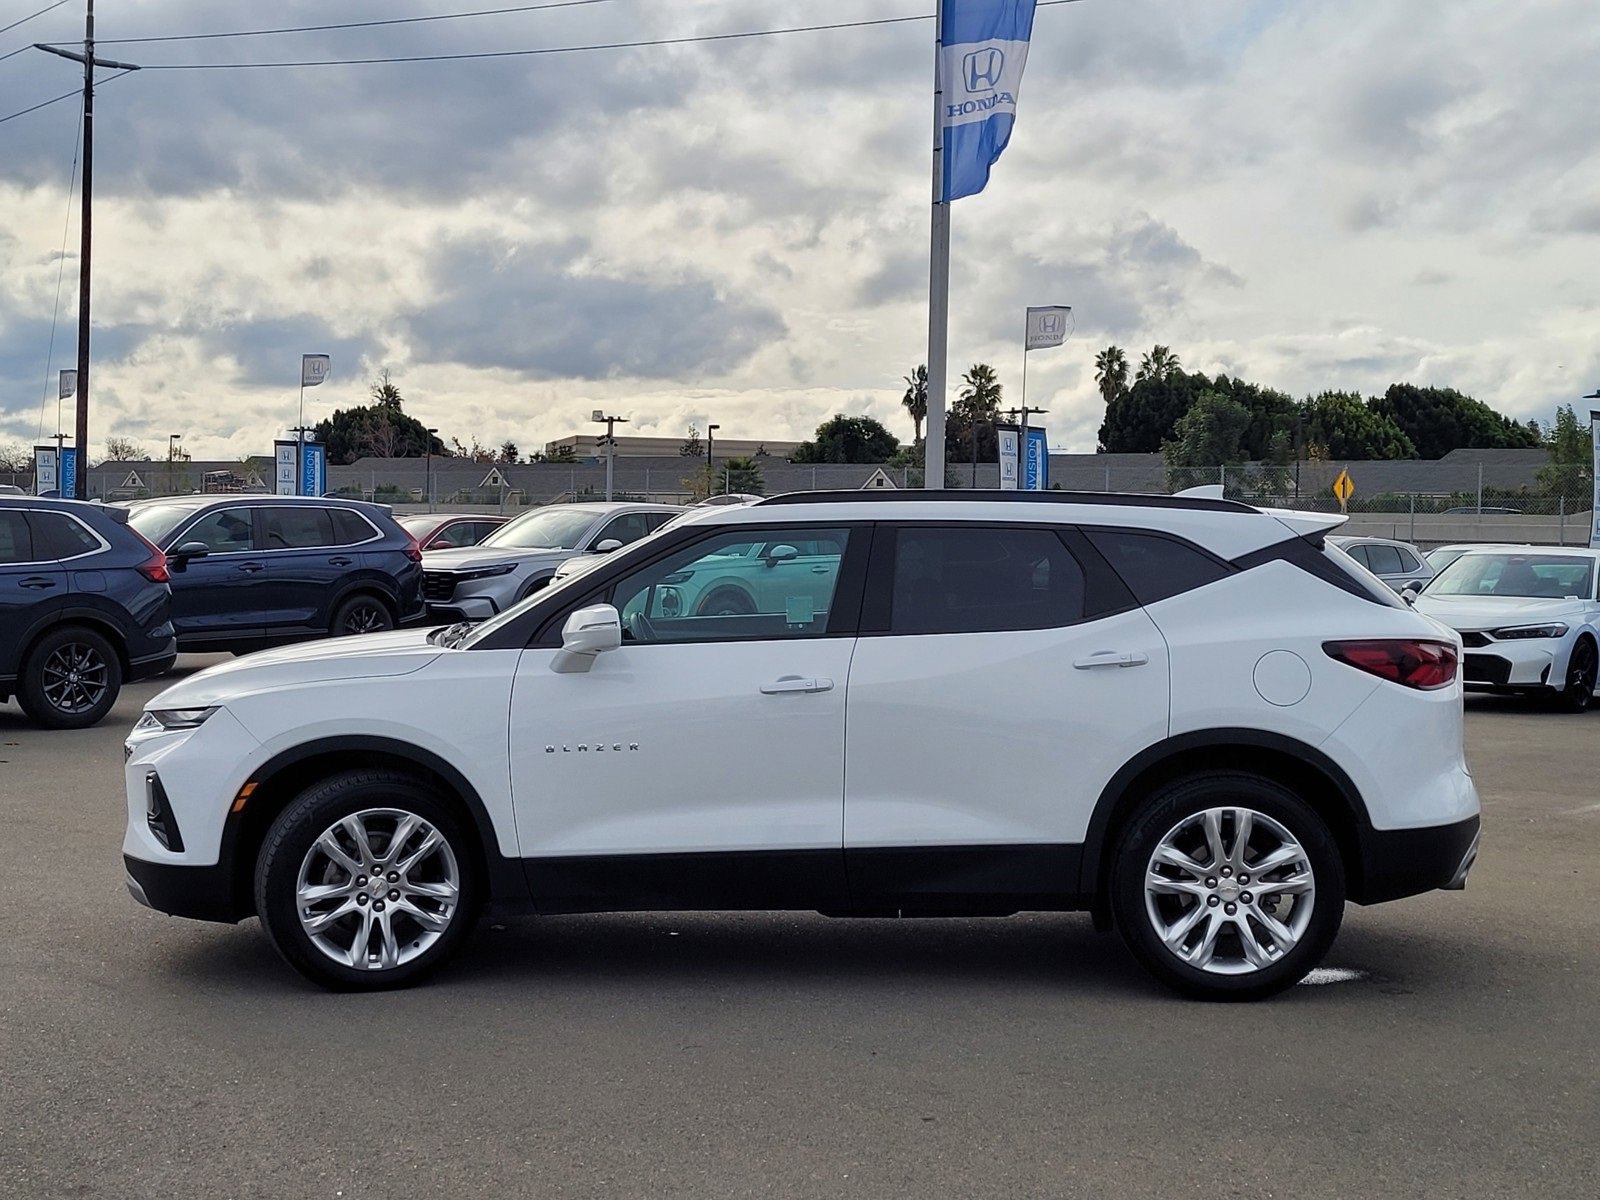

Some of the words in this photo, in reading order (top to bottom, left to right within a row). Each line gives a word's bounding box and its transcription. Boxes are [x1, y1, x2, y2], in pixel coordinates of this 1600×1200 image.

[947, 92, 1016, 117] HONDA
[66, 454, 75, 497] ENVISION
[545, 742, 639, 753] BLAZER
